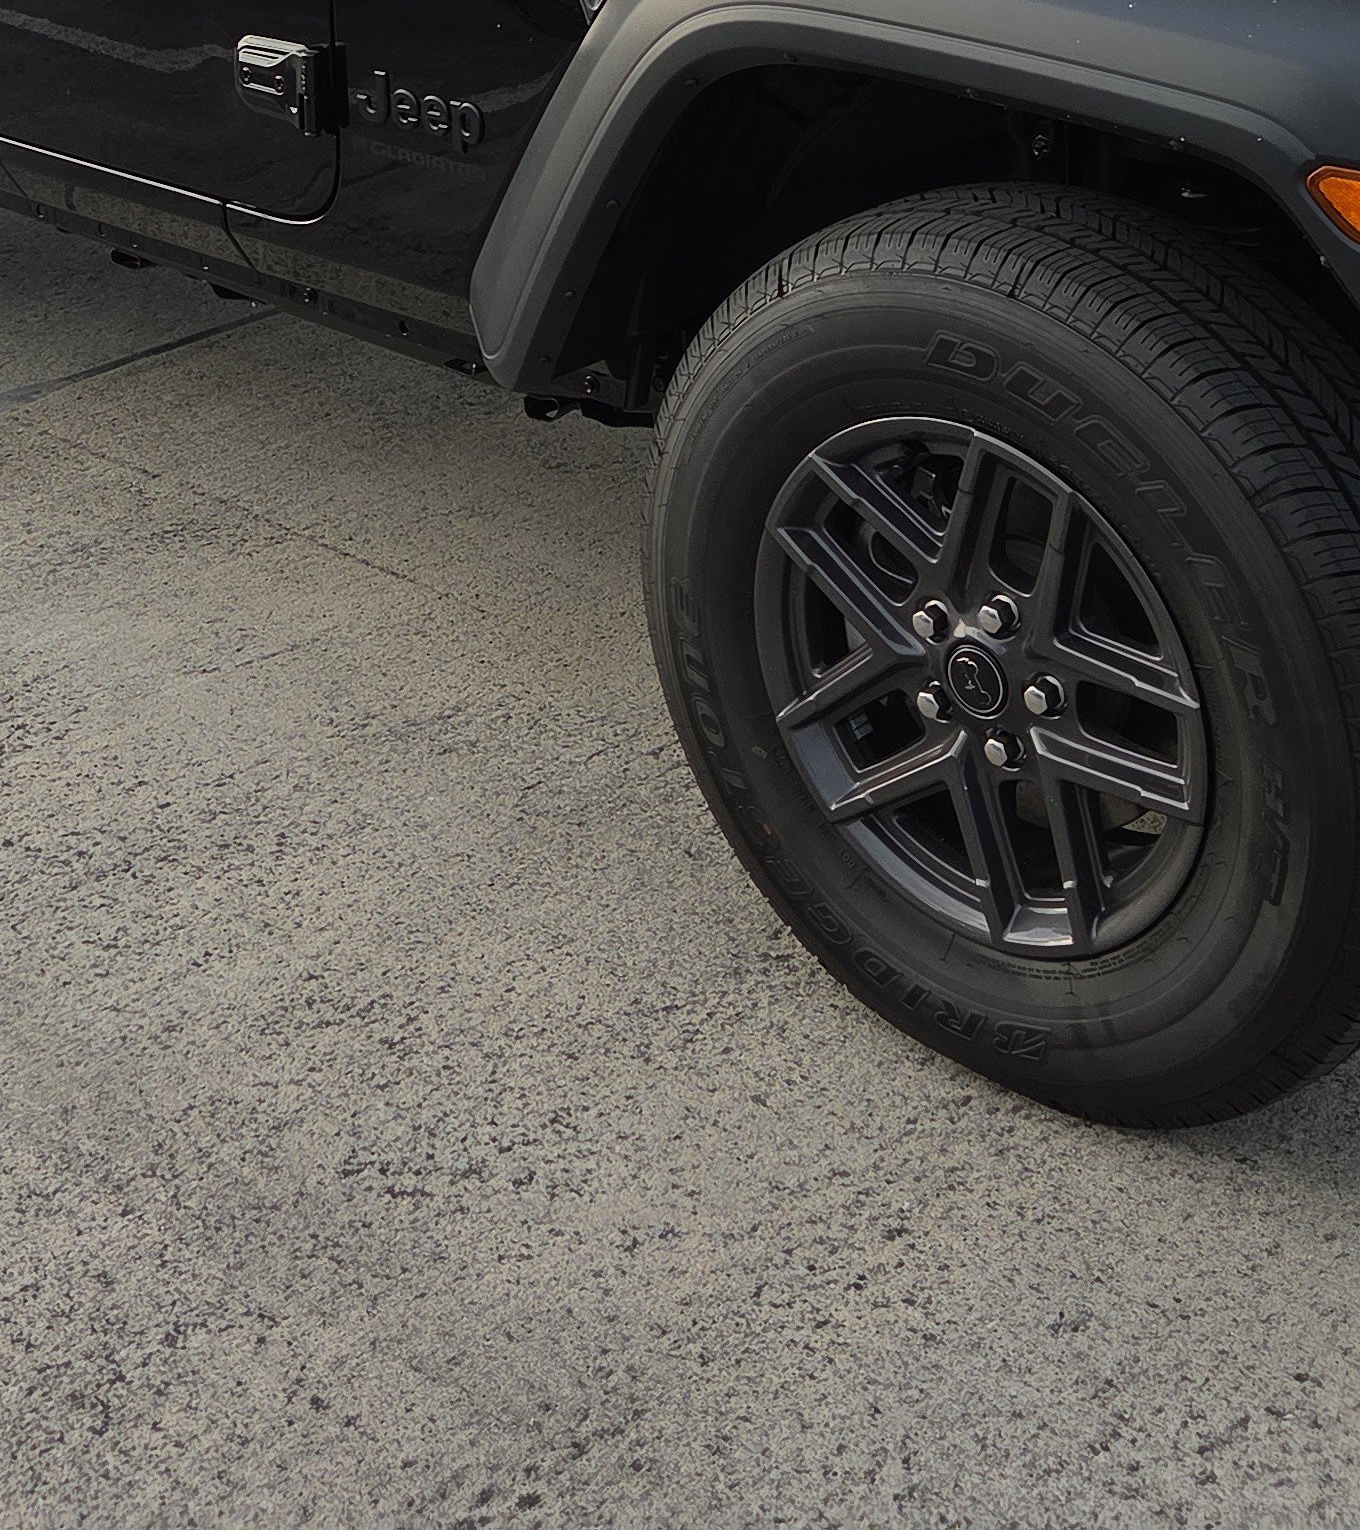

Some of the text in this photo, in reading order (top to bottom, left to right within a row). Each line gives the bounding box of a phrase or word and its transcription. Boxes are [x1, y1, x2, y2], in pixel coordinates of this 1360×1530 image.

[355, 70, 486, 155] Jeep
[925, 329, 1282, 726] DUELER
[668, 574, 1051, 1062] BRIDGESTONE
